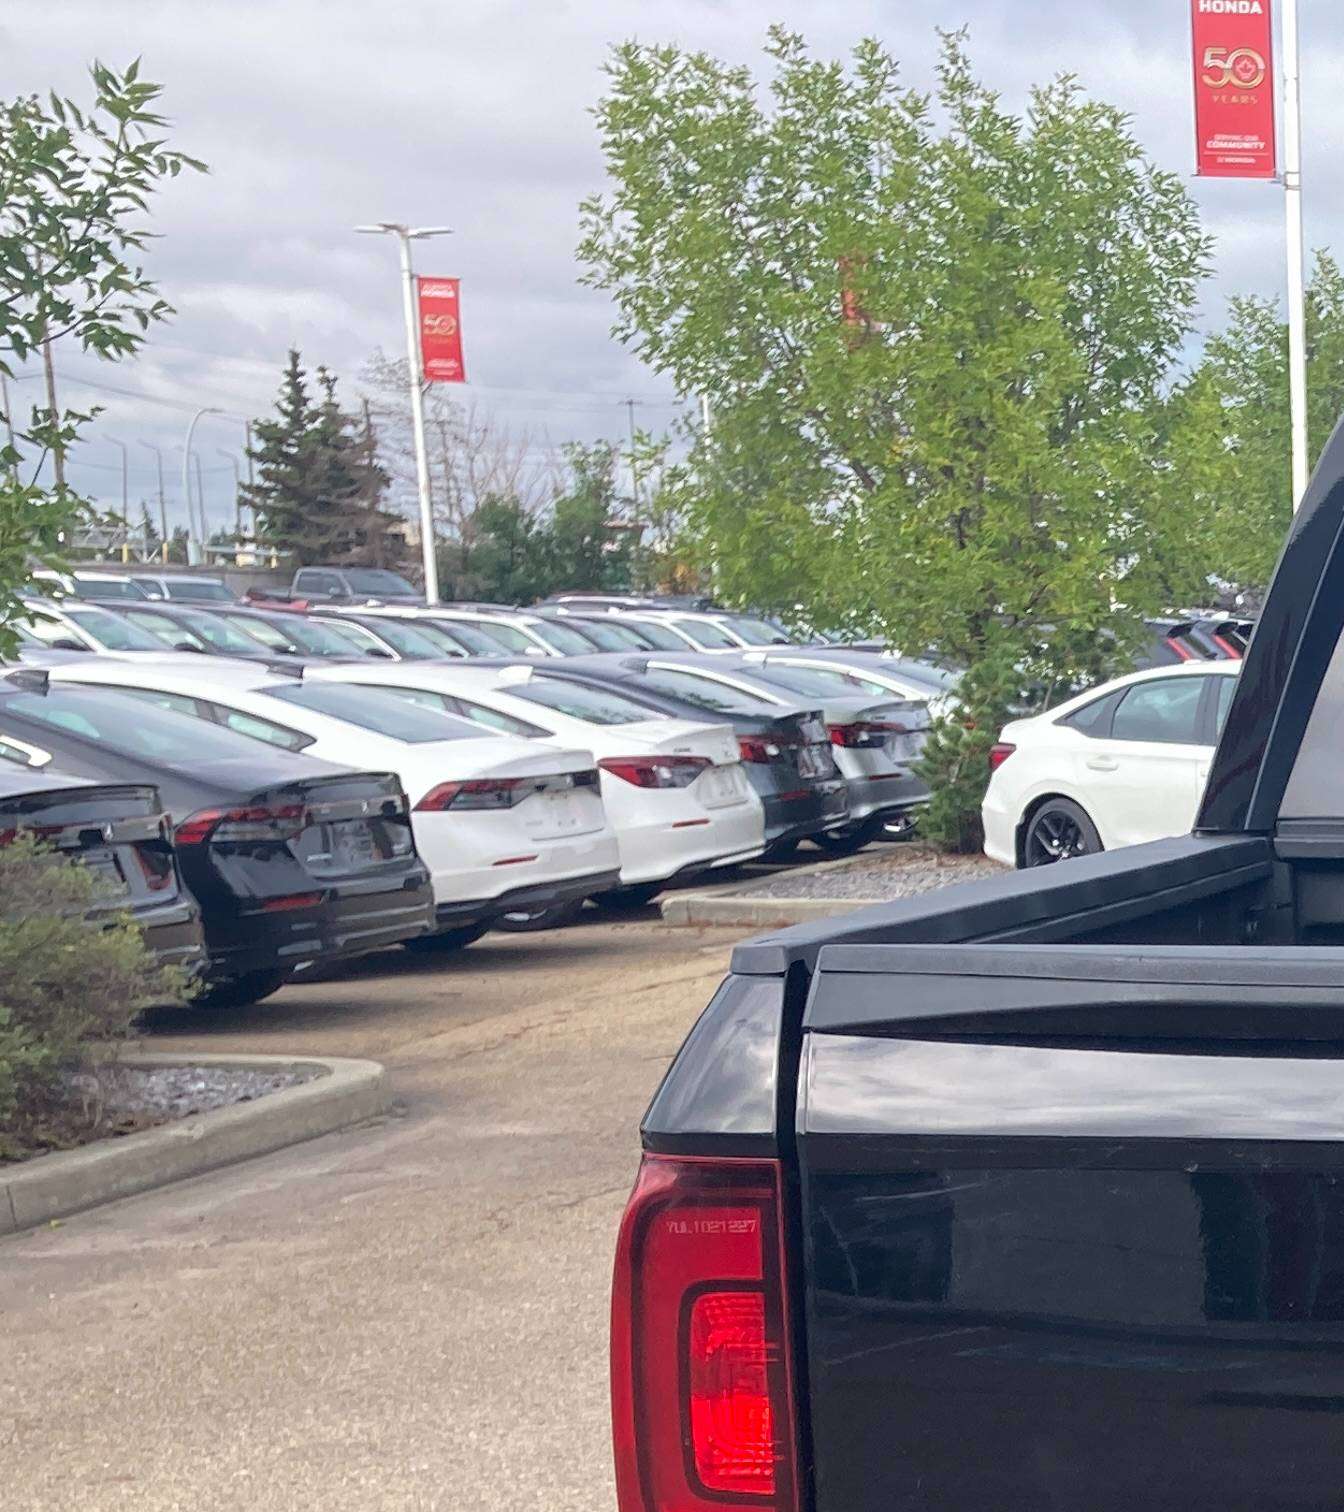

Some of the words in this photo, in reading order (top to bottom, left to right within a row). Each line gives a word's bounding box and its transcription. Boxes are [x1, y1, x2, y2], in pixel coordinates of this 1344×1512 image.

[1199, 0, 1263, 14] HONDA
[1201, 47, 1265, 89] 50
[1206, 140, 1265, 149] COMMUNITY
